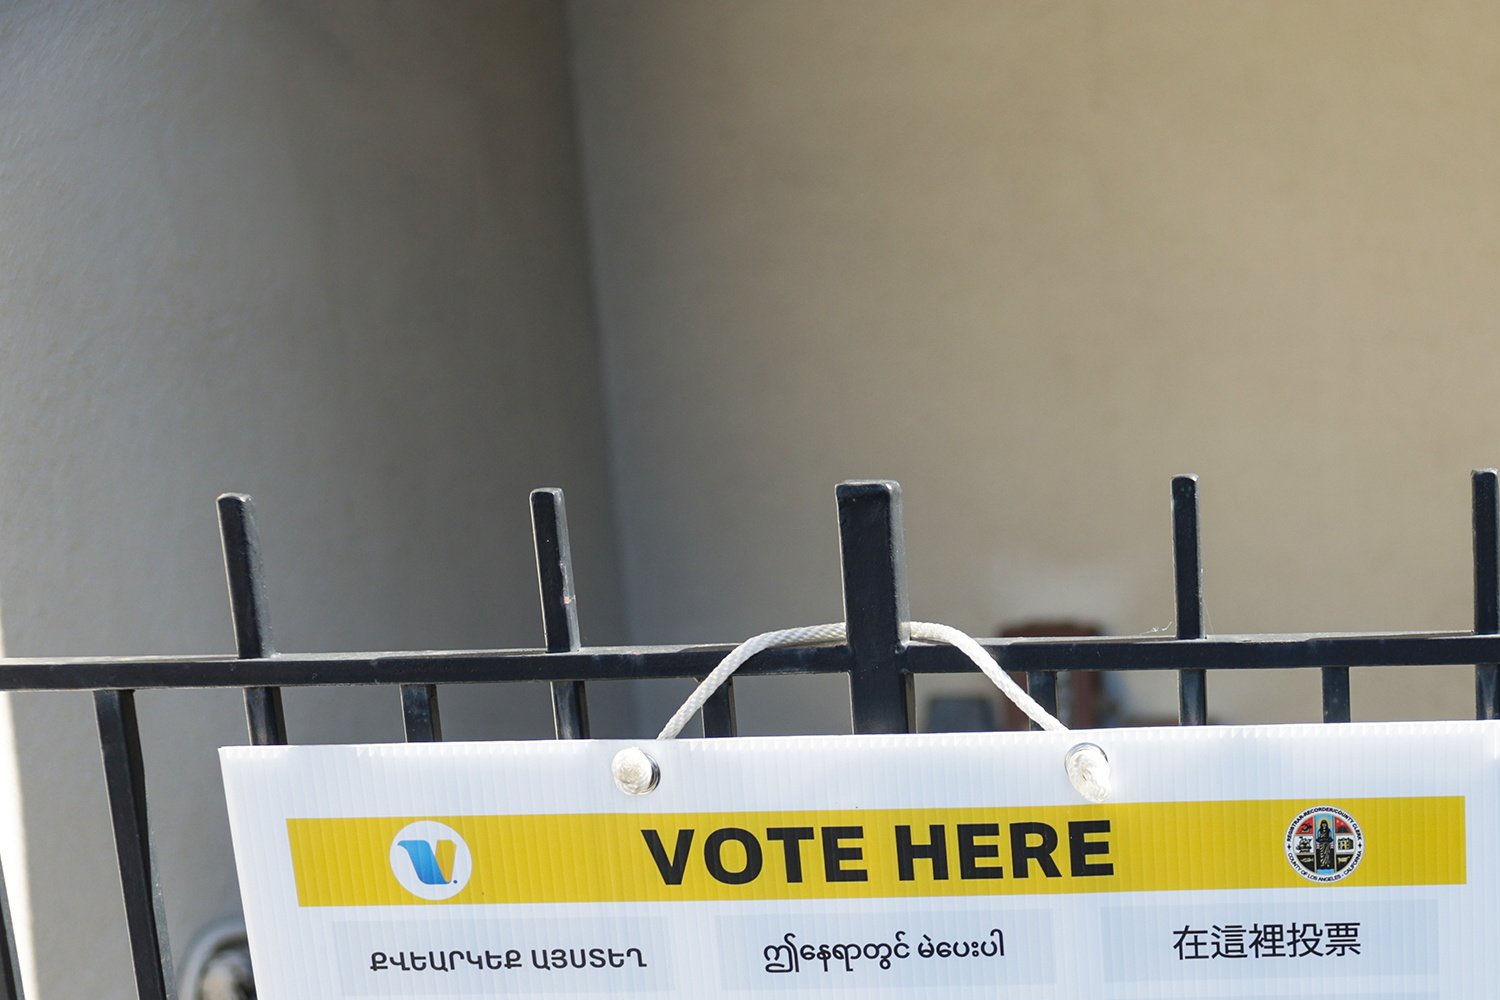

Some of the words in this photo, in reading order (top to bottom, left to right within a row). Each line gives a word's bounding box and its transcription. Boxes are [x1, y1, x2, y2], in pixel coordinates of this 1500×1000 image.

[641, 826, 868, 885] VOTE
[895, 820, 1114, 881] HERE
[1173, 922, 1361, 960] 在這裡投票
